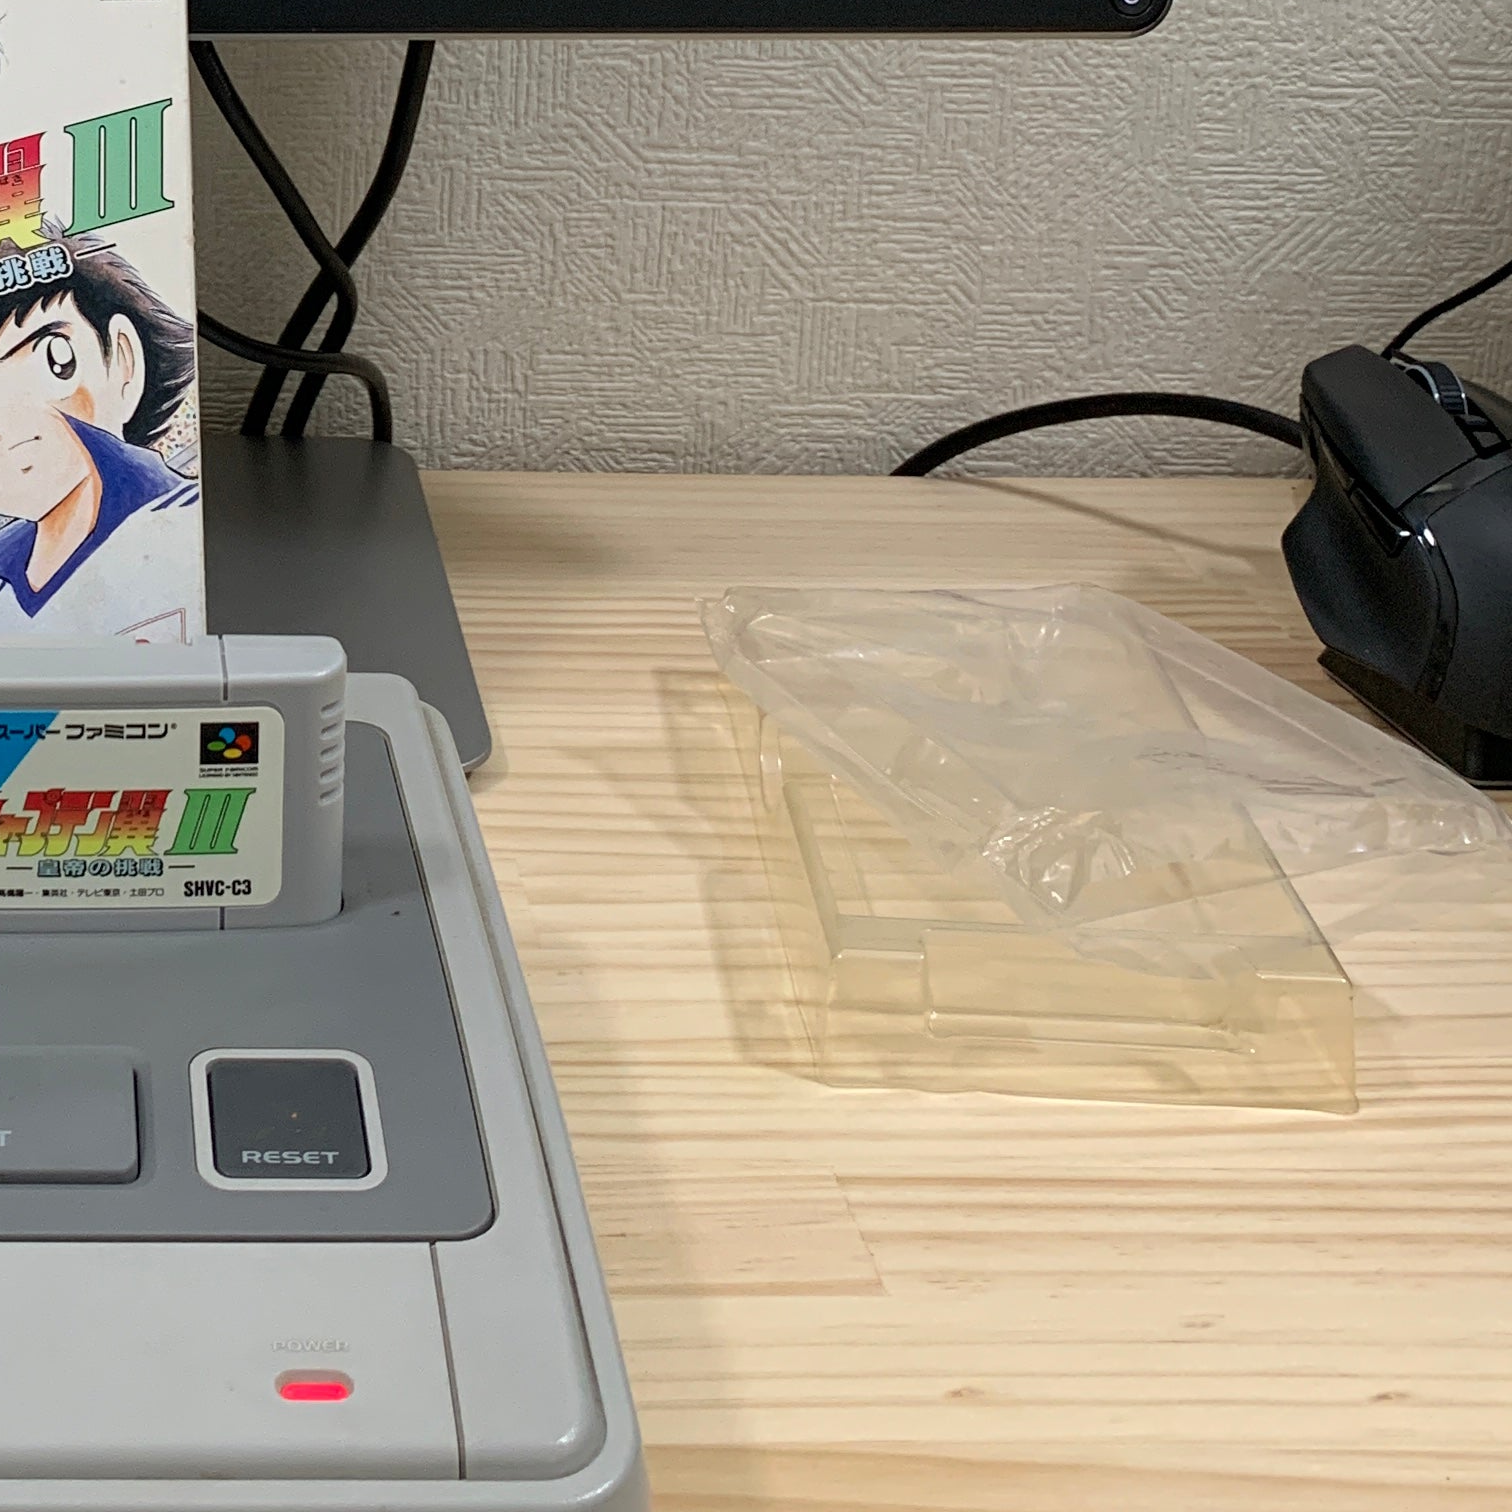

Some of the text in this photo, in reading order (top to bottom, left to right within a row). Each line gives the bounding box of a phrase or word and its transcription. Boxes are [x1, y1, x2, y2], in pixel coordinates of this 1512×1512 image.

[38, 858, 164, 878] 皇帝の挑戦
[184, 879, 252, 897] SHVC-C3
[240, 1148, 340, 1166] RESET
[272, 1339, 350, 1353] POWER
